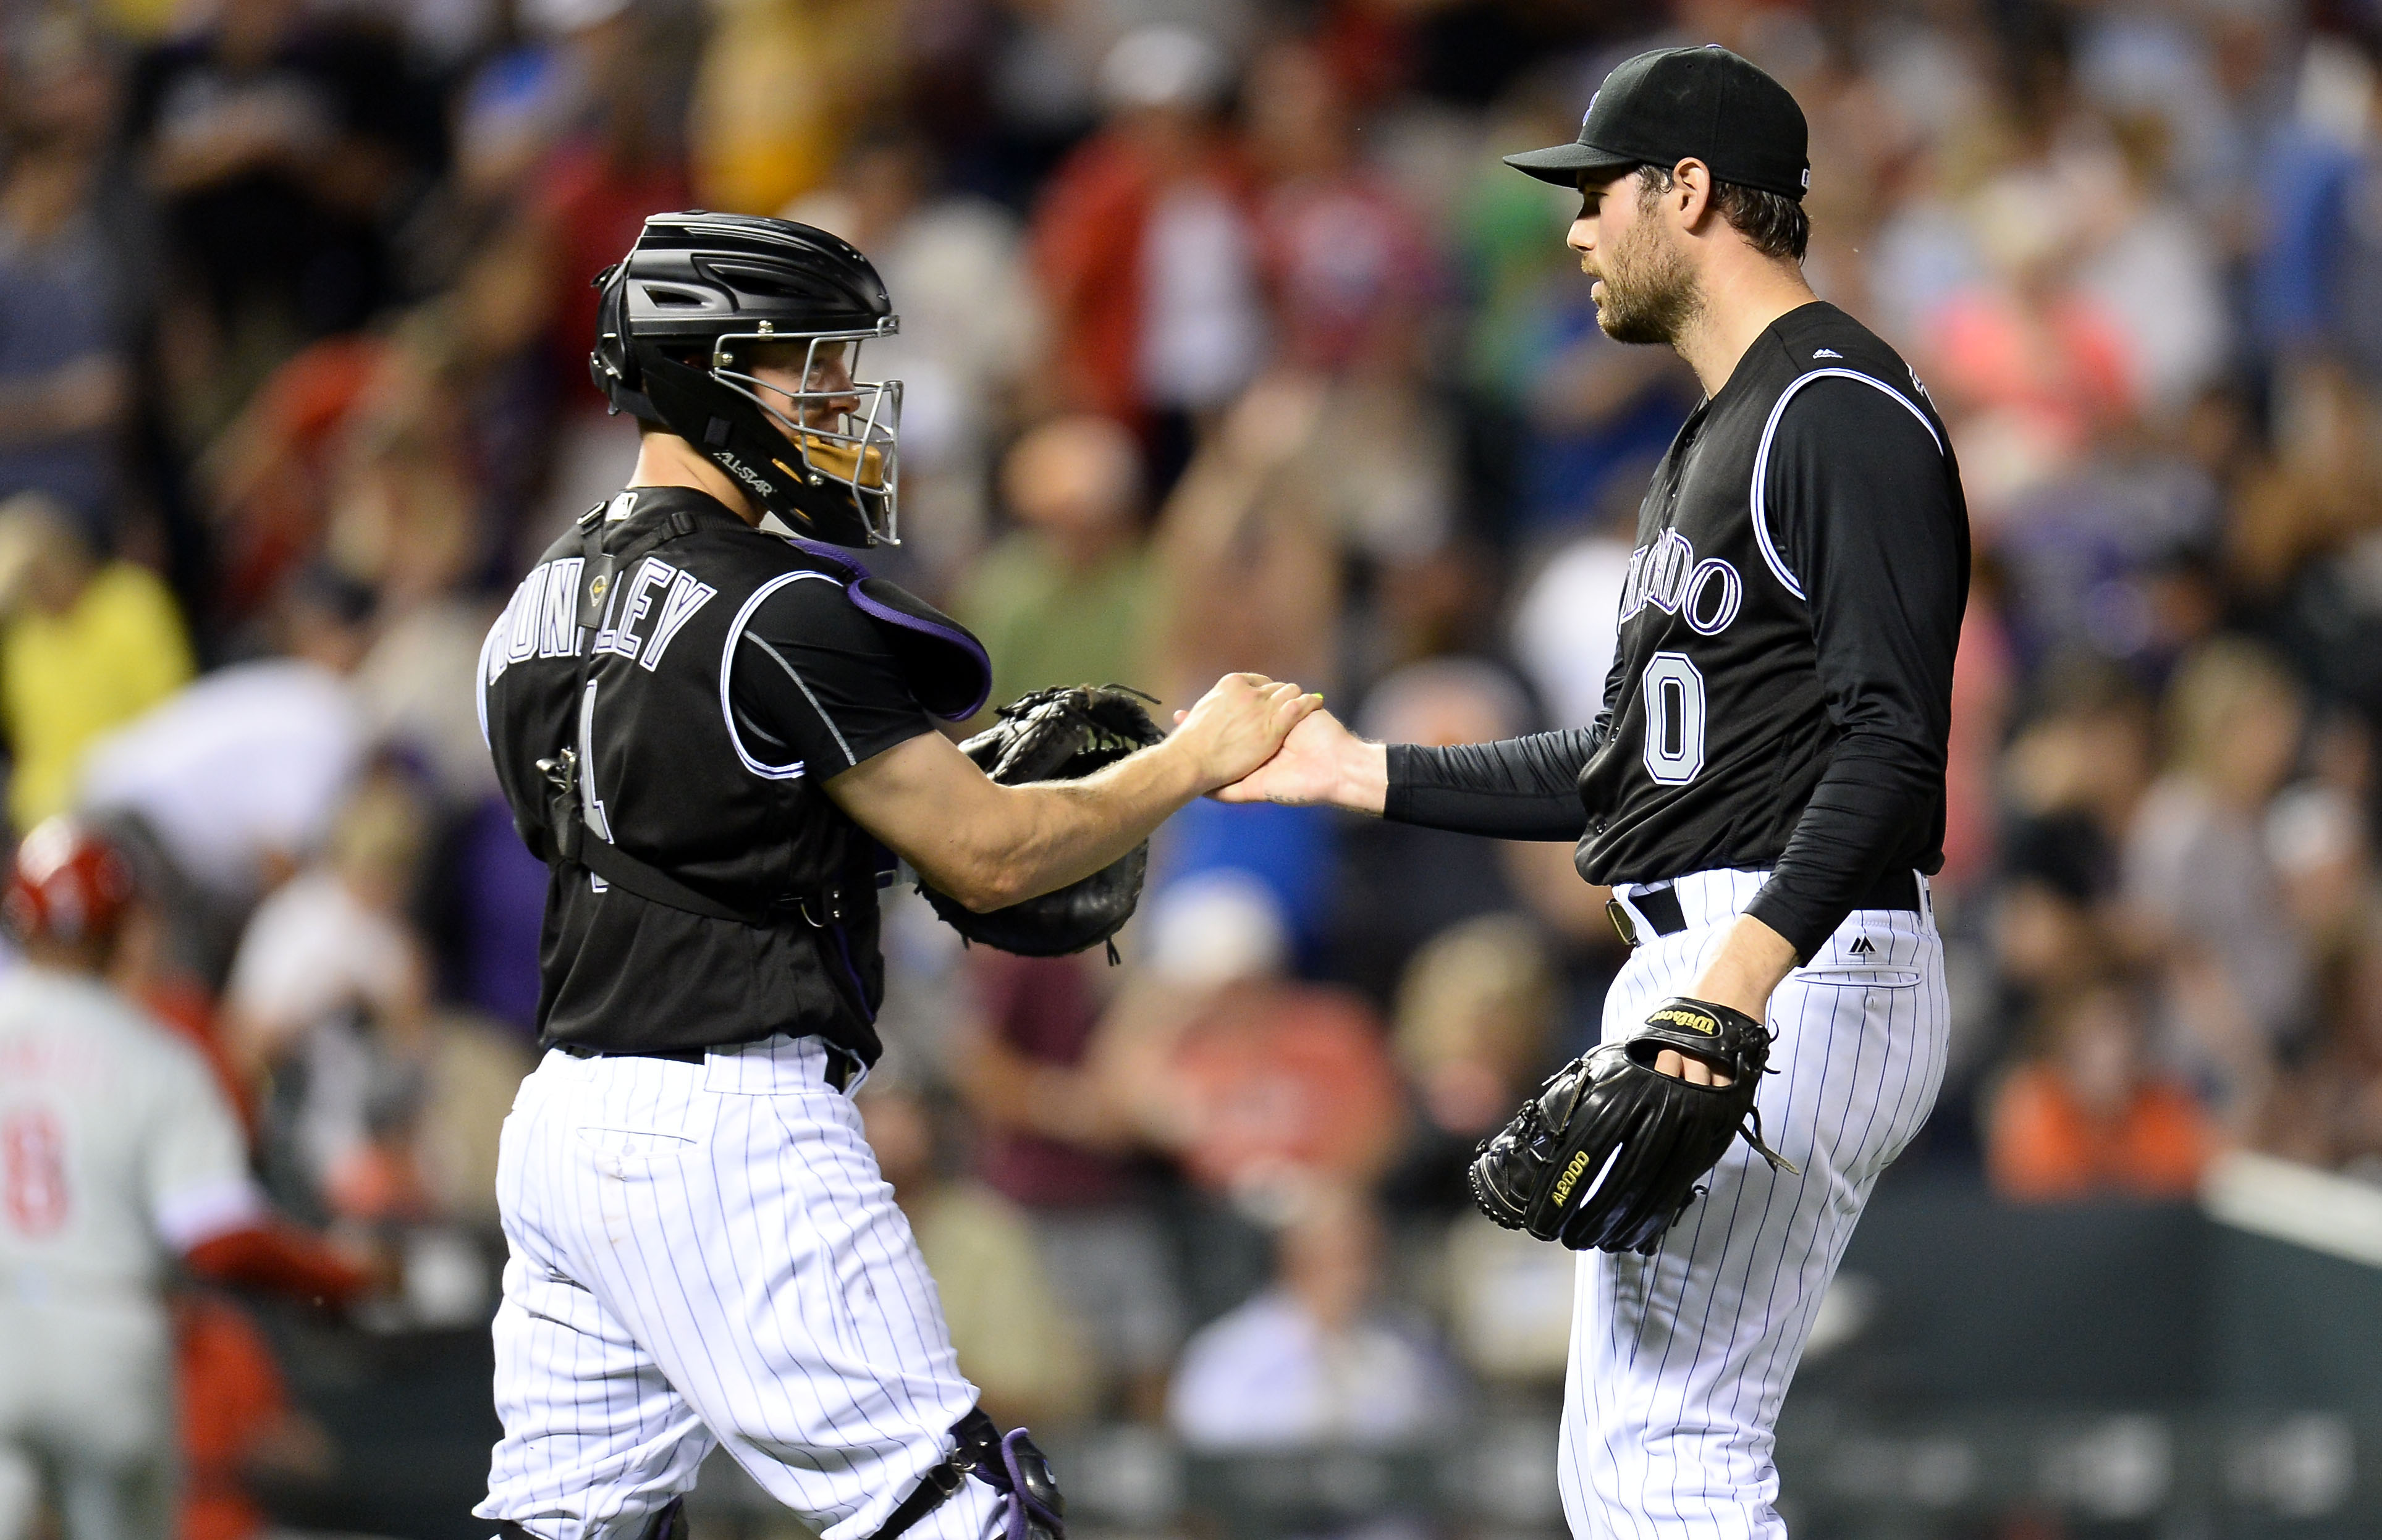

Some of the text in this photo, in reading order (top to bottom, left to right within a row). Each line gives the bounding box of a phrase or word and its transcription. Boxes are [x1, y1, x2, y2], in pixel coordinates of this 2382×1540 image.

[1642, 651, 1707, 786] 0
[1647, 1010, 1715, 1035] Wilson
[1552, 1150, 1590, 1208] A2000
